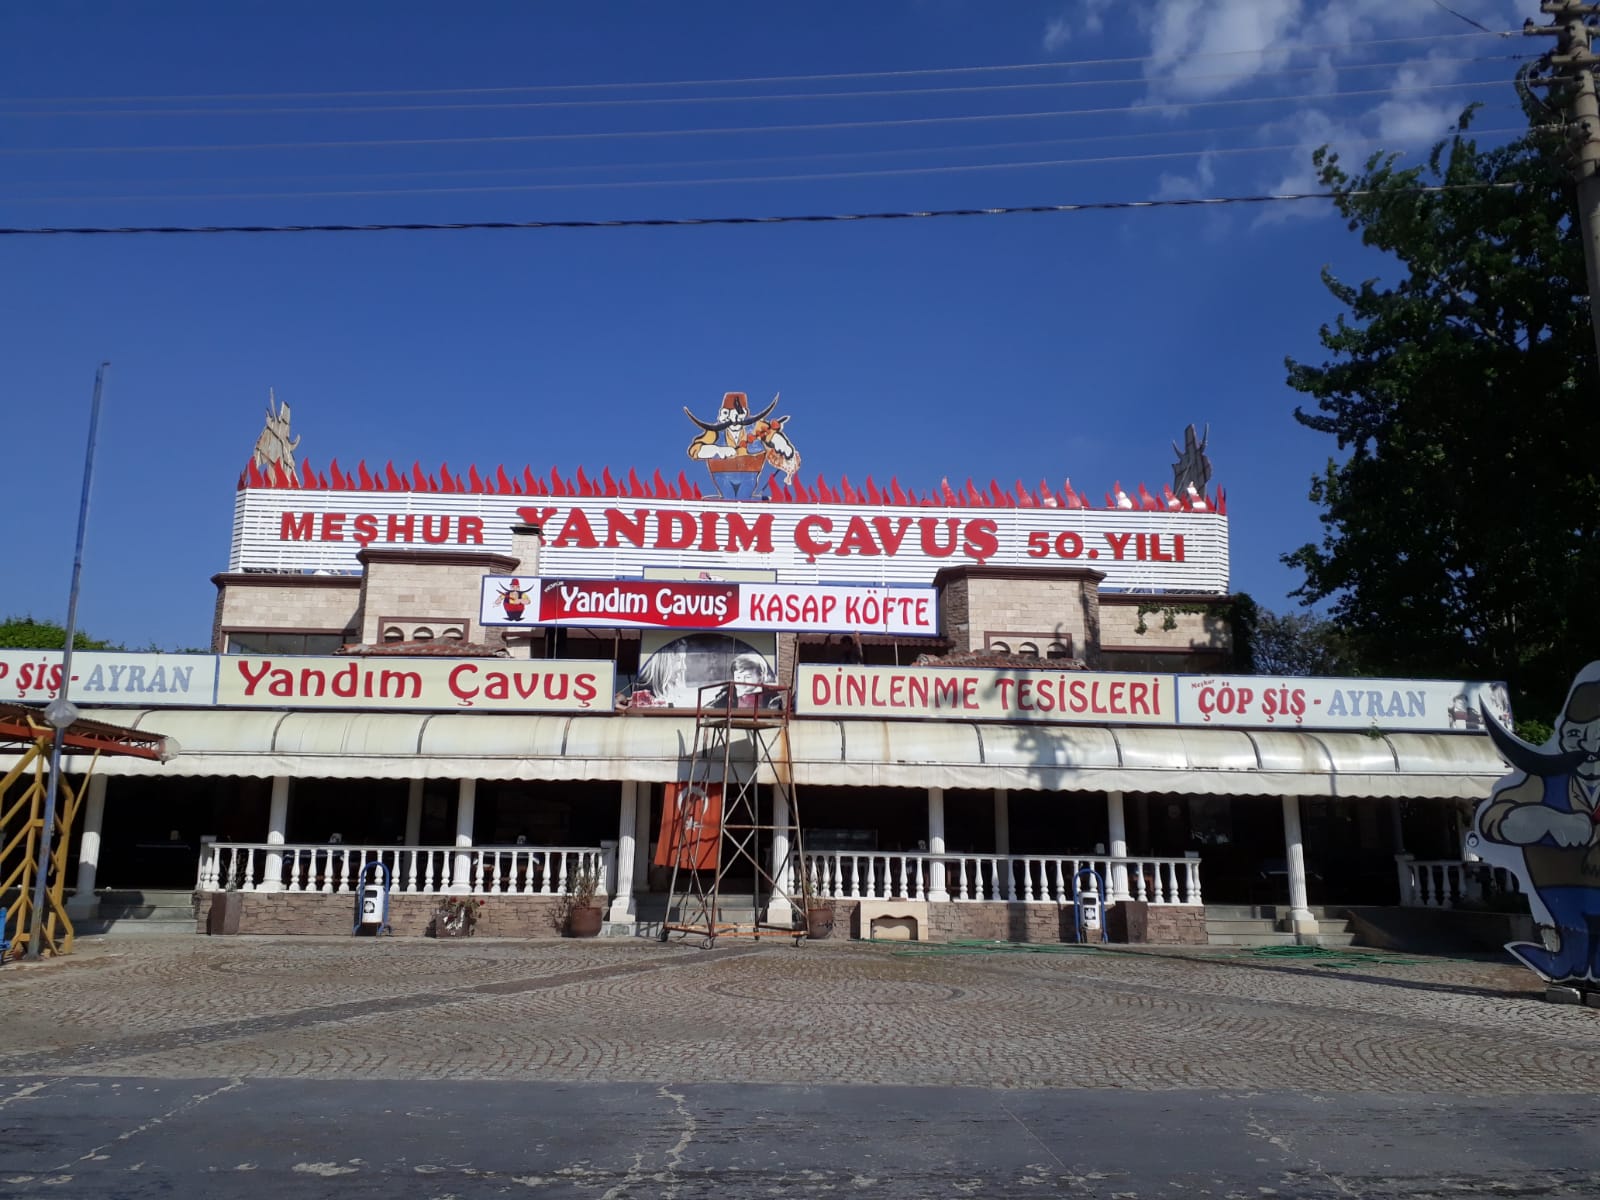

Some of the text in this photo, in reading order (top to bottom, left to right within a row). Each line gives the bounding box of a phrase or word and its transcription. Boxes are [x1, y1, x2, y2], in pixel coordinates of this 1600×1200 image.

[280, 511, 484, 547] MEŞHUR
[793, 514, 999, 565] ÇAVUŞ
[560, 586, 728, 623] Yandım Çavuş
[749, 590, 930, 626] KASAP KÖFTE
[83, 663, 193, 693] AYRAN
[237, 660, 597, 708] Yandım Çavuş
[811, 667, 1161, 716] DİNLENME TESİSLERİ
[1198, 681, 1254, 722] ÇÖP
[1262, 683, 1306, 724] ŞİŞ
[1327, 689, 1427, 717] AYRAN
